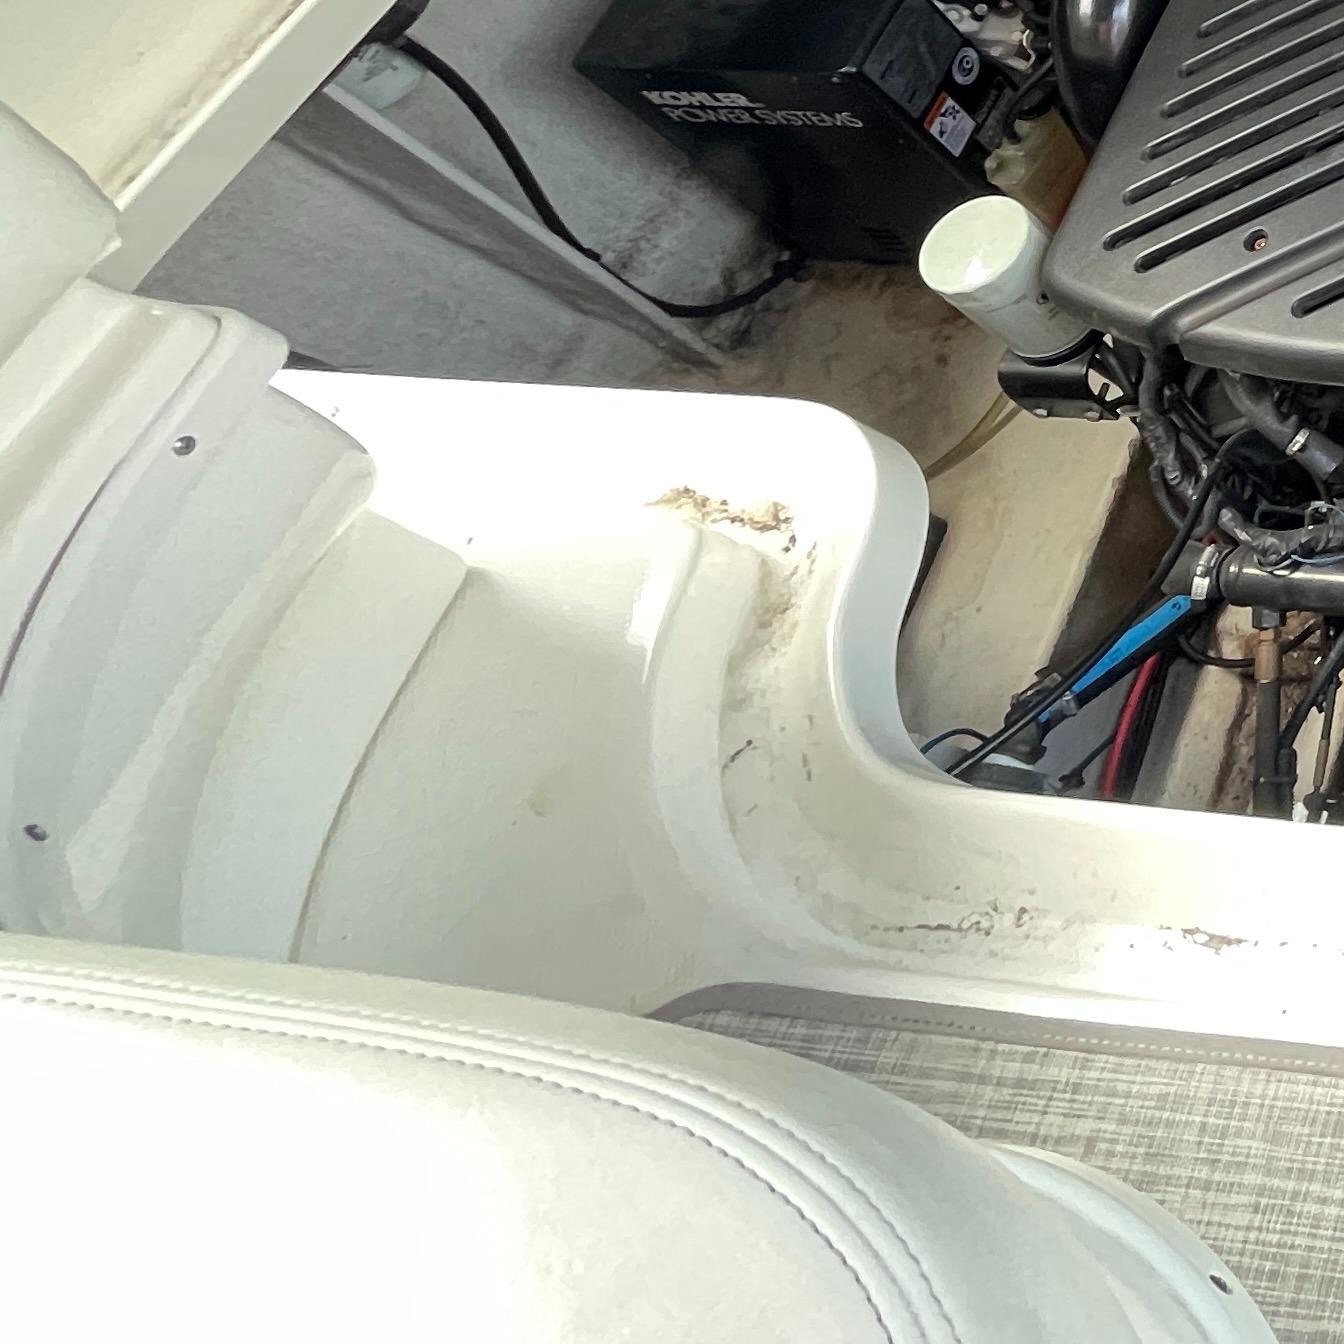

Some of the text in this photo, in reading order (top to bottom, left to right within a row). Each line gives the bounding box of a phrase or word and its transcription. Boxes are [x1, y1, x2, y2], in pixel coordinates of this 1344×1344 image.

[641, 90, 766, 107] KOHLER
[661, 107, 864, 128] POWER SYSTEMS
